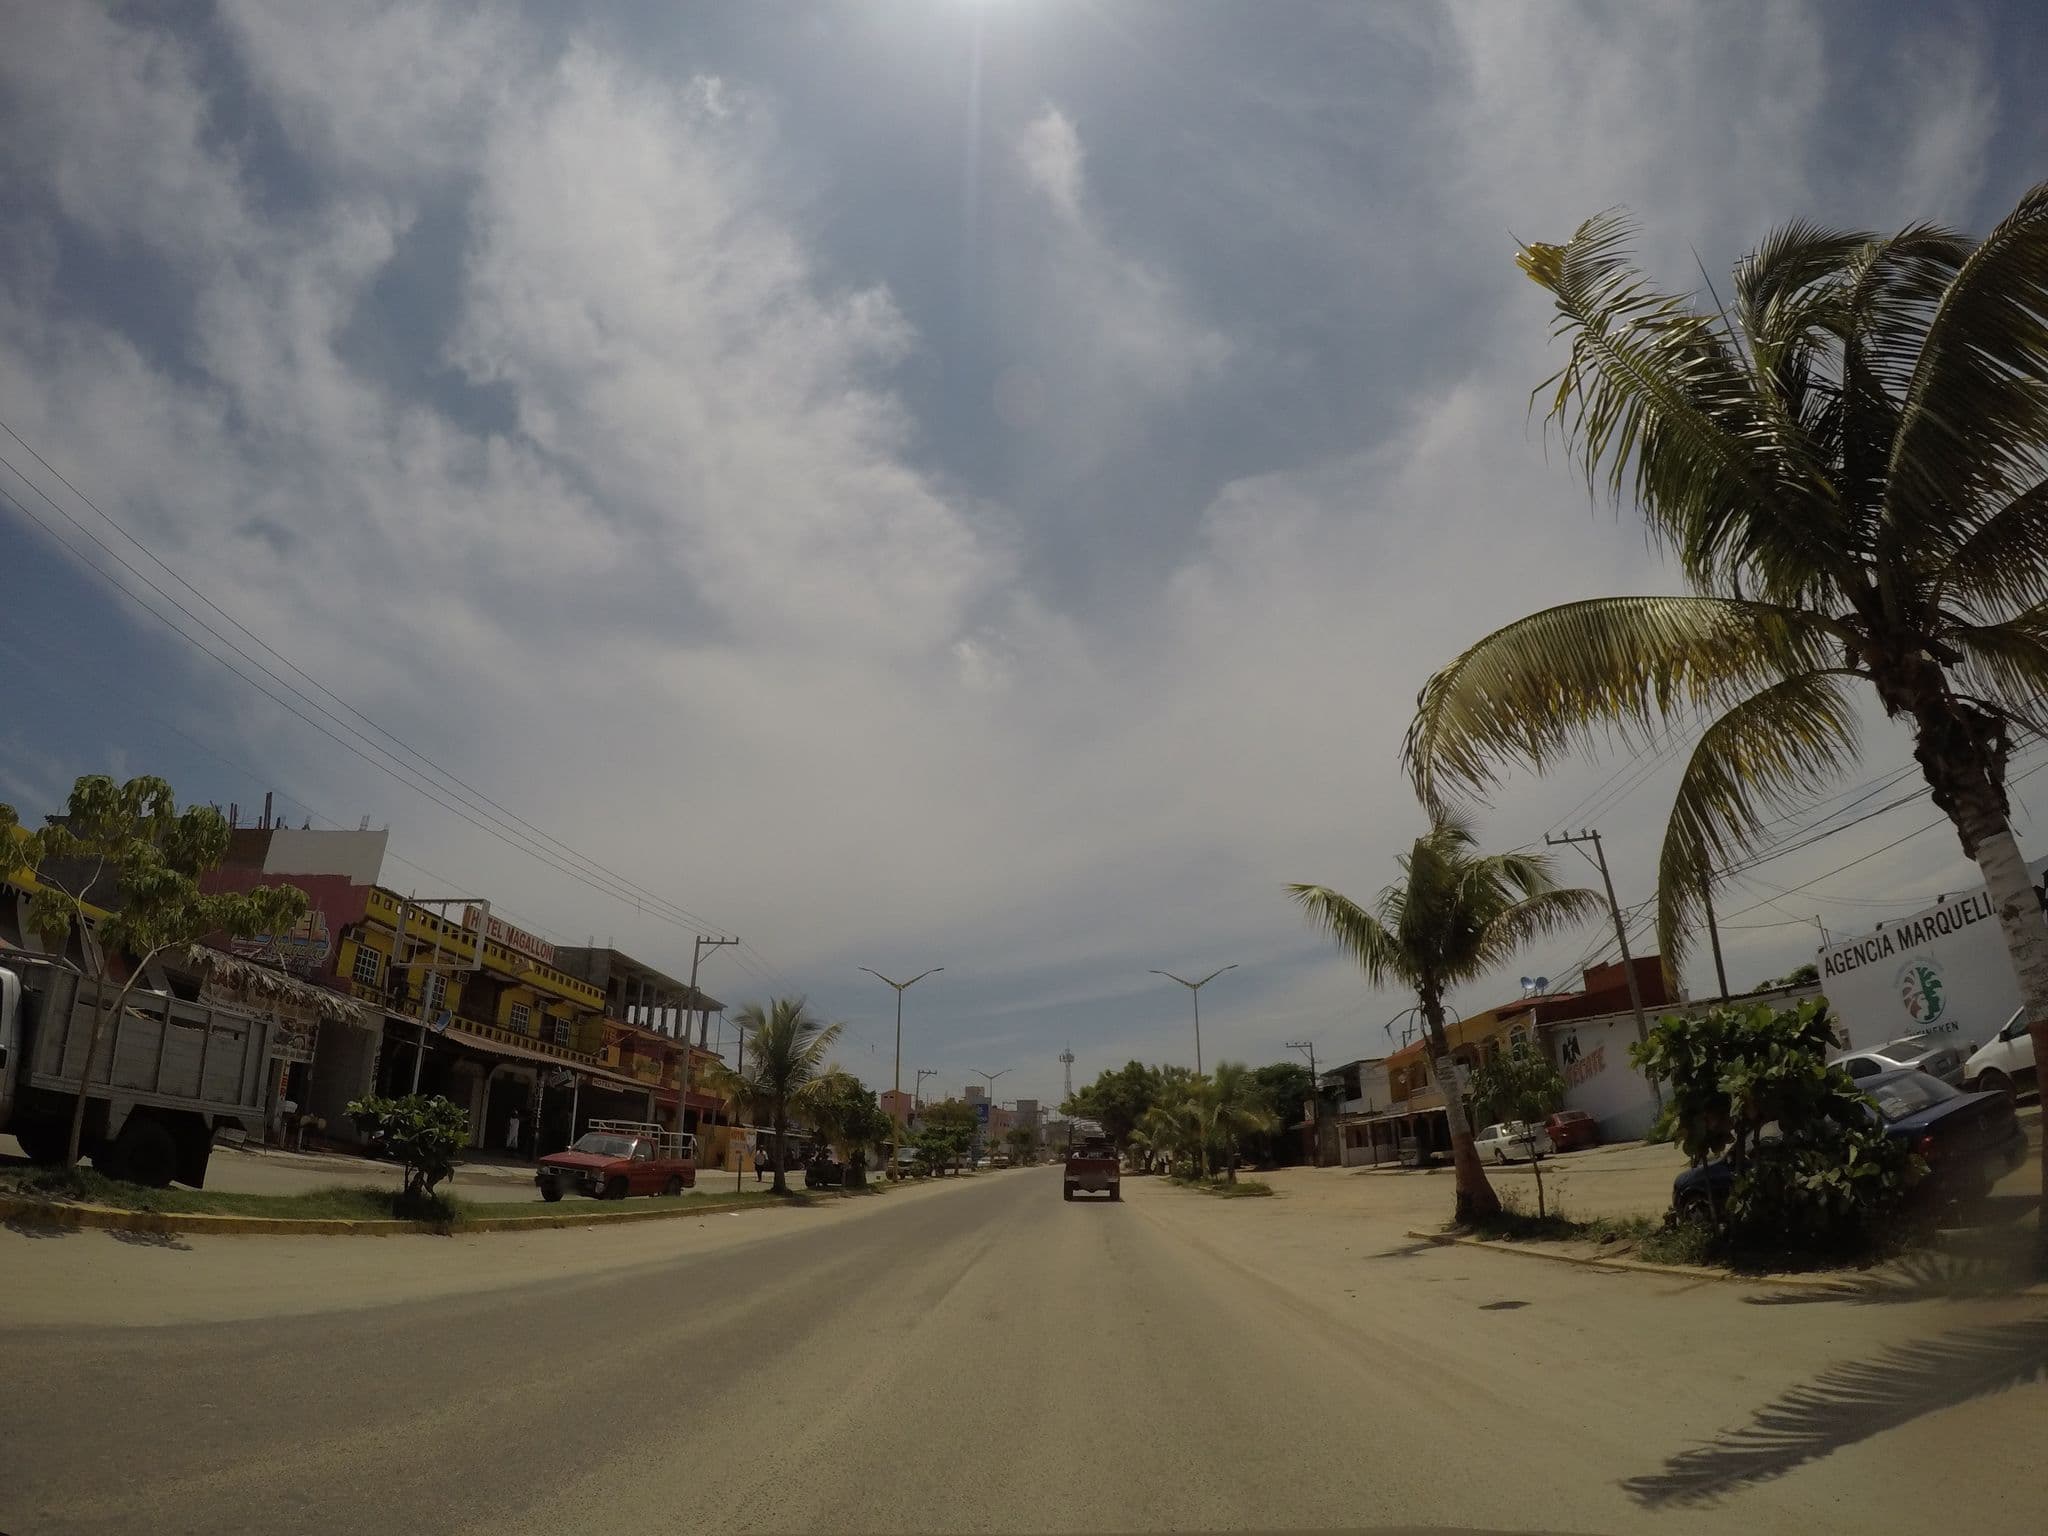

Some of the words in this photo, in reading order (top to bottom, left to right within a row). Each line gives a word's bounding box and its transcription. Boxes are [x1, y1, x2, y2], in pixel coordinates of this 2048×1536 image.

[471, 908, 502, 939] HTEL
[505, 926, 554, 961] MAGALLON
[1825, 934, 1894, 978] AGENCIA
[1897, 891, 1997, 951] MARQUELI
